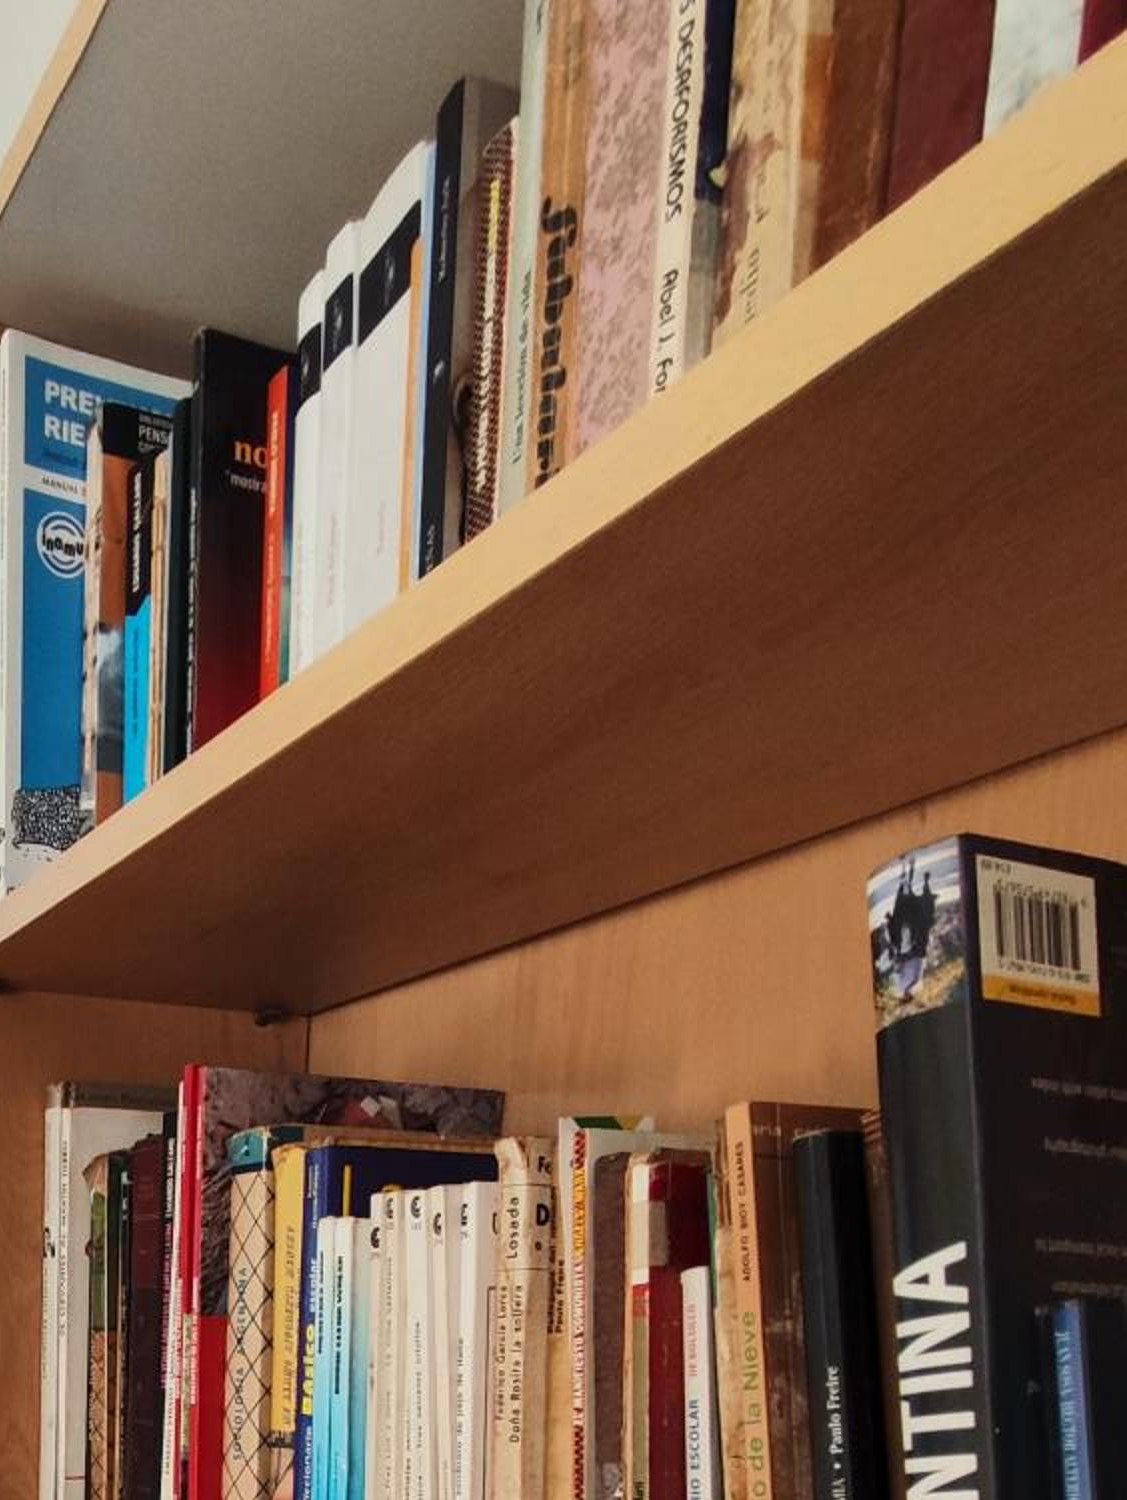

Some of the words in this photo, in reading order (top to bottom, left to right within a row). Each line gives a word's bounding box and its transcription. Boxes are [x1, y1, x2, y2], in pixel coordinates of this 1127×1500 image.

[666, 19, 695, 222] DESAFORISMOS
[658, 269, 679, 327] Abel
[735, 1140, 747, 1195] CASARES
[507, 1197, 519, 1259] Losada
[739, 1235, 751, 1281] ADOLFO
[741, 1311, 759, 1391] Nieve
[826, 1365, 840, 1409] Freire
[508, 1408, 520, 1443] Doña
[688, 1399, 701, 1469] ESCOLAR
[744, 1402, 761, 1425] la
[829, 1412, 843, 1454] Paulo
[746, 1436, 763, 1471] de
